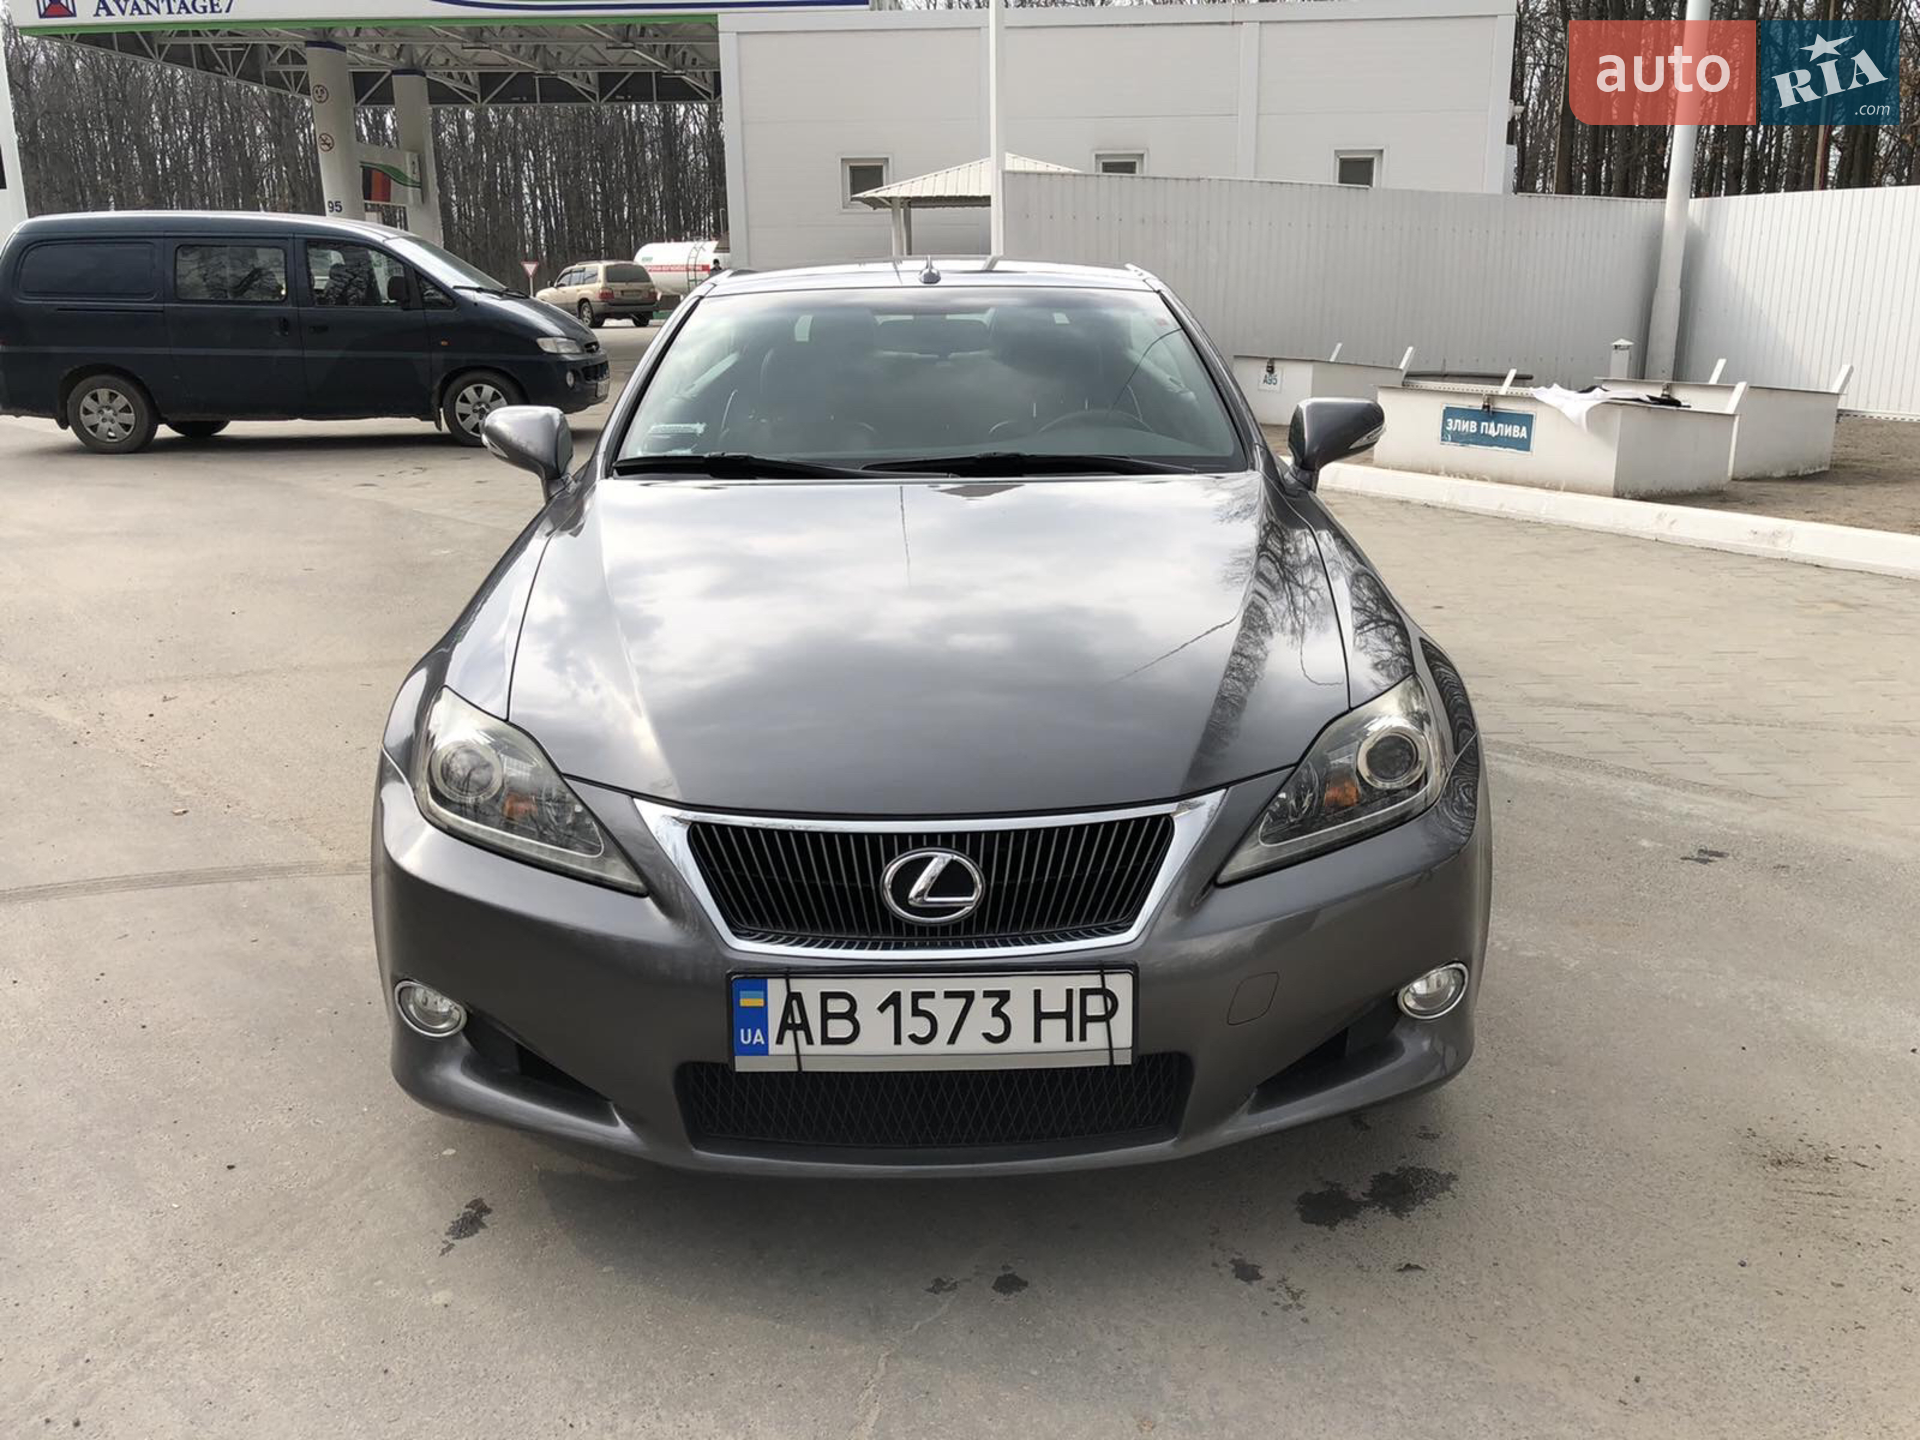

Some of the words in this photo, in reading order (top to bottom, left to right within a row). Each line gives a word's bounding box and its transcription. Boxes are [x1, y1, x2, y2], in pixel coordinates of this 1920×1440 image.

[327, 201, 342, 212] 95
[1445, 418, 1477, 433] ЗЛИВ
[775, 991, 860, 1046] AB
[876, 990, 1012, 1045] 1573
[1033, 988, 1119, 1043] HP
[740, 1028, 765, 1045] UA
